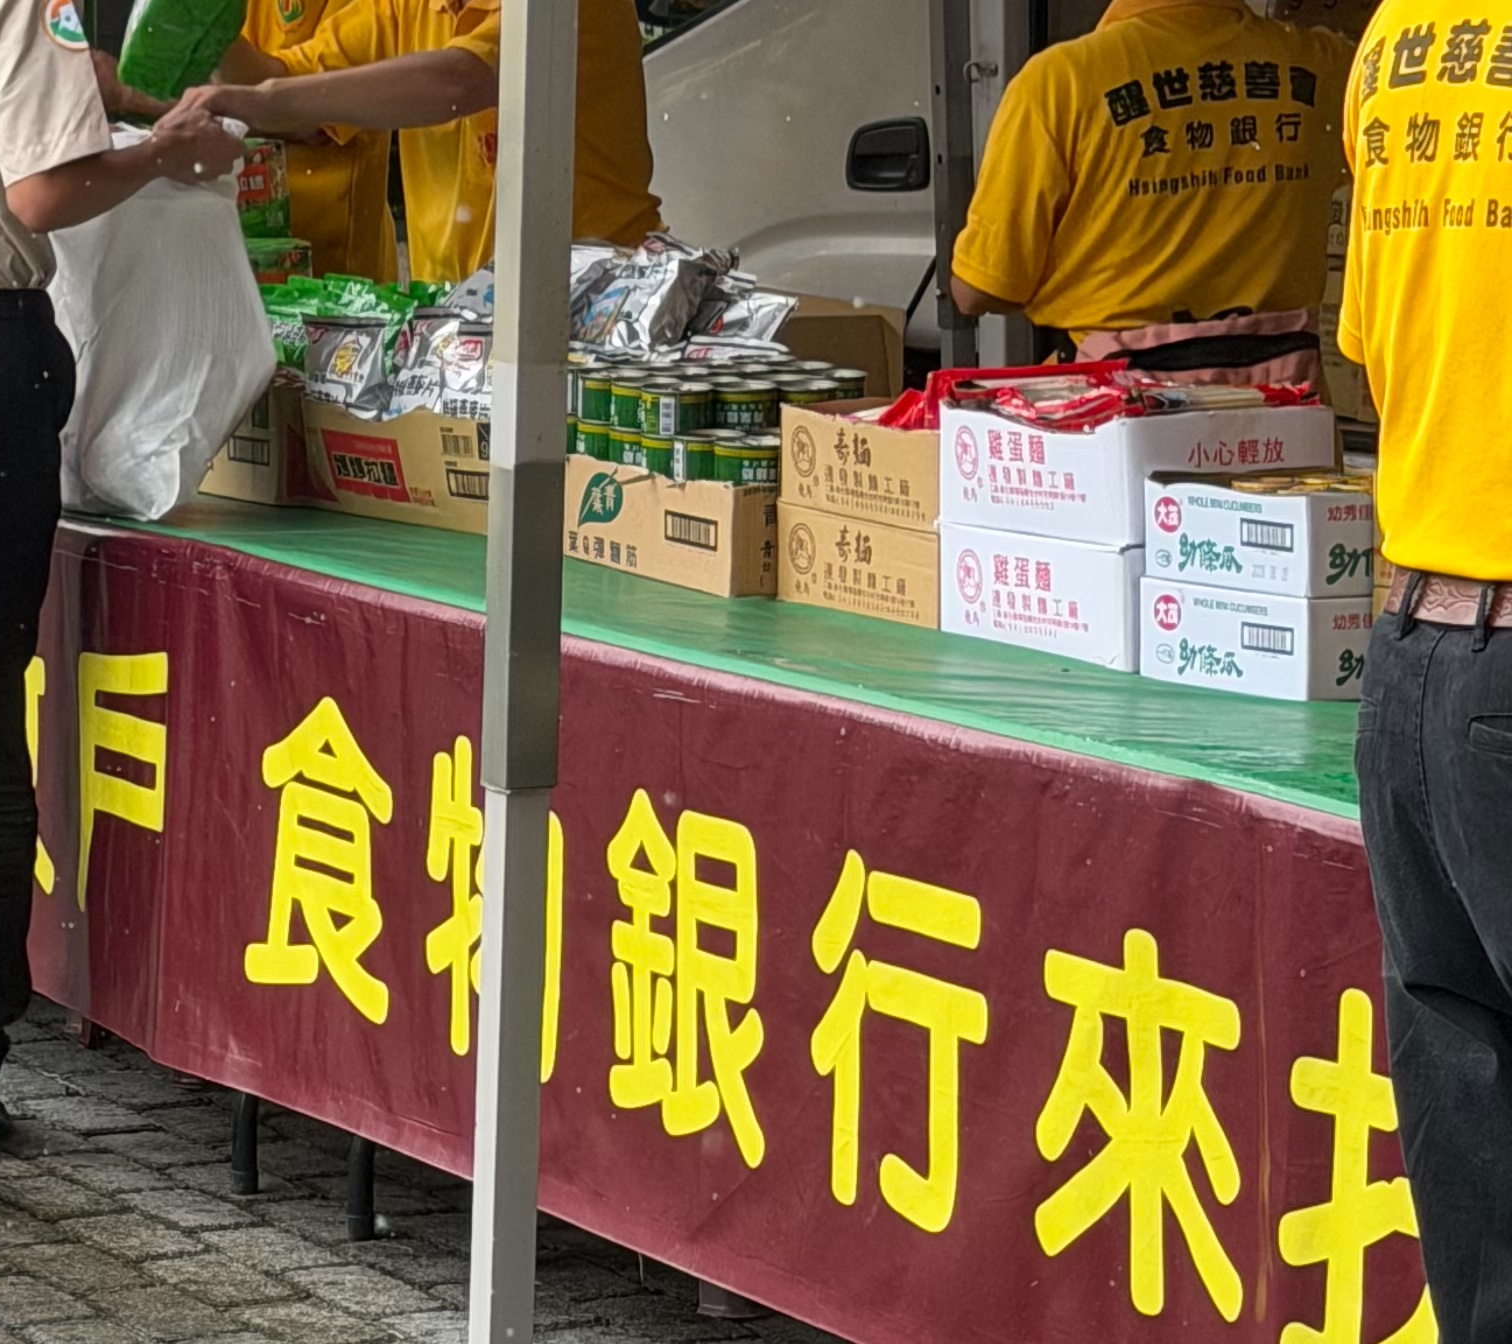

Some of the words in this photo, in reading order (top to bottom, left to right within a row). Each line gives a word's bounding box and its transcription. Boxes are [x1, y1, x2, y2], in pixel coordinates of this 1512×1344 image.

[1140, 112, 1302, 158] 食物銀行
[1442, 198, 1475, 228] Food
[1188, 437, 1285, 469] 小心輕放
